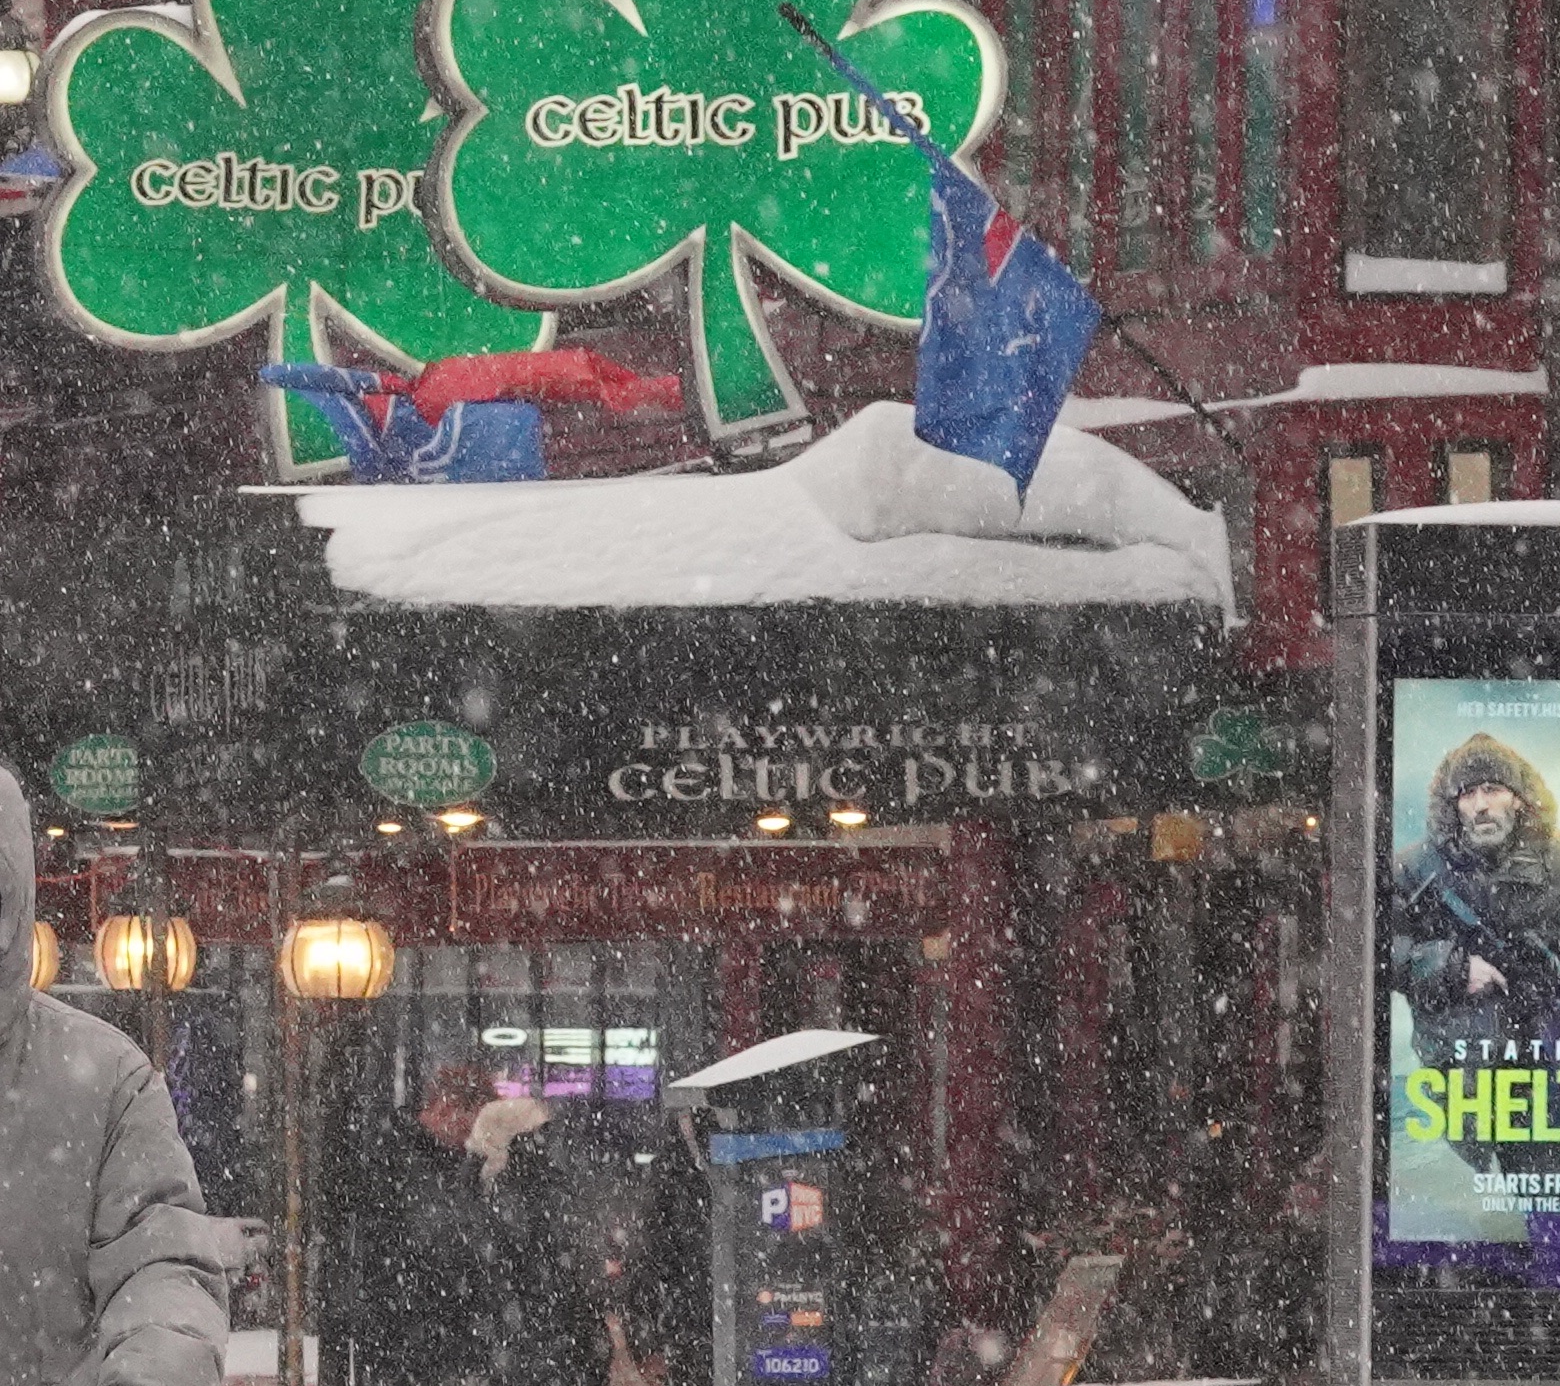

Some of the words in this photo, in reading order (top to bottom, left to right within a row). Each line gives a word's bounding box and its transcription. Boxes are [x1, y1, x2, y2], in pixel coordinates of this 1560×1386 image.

[385, 733, 471, 754] PARTY
[64, 767, 139, 785] ROOM
[1473, 1172, 1541, 1195] STARTS
[762, 1187, 789, 1224] P
[1482, 1197, 1516, 1213] ONLY
[1518, 1197, 1532, 1212] IN
[764, 1357, 821, 1374] 106210
